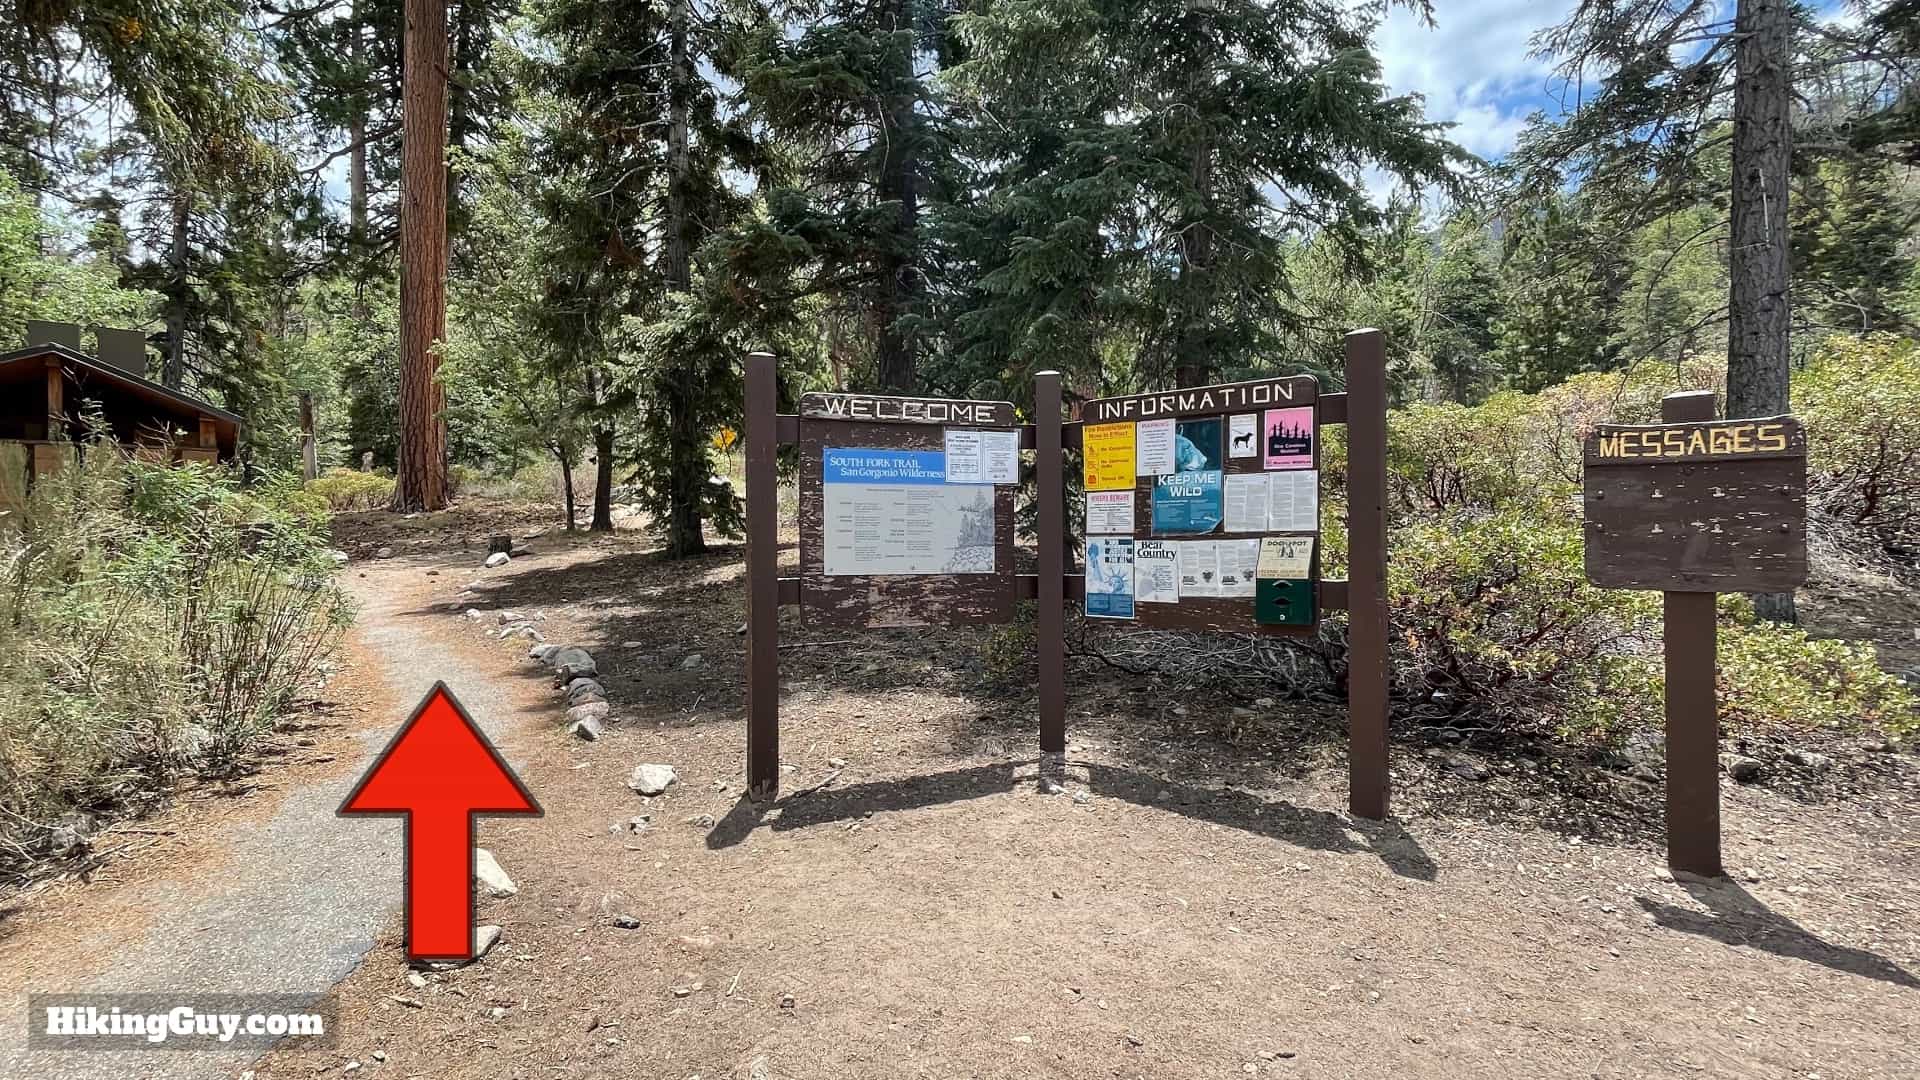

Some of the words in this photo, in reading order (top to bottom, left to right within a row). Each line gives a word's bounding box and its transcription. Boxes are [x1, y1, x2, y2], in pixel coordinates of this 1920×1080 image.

[1099, 382, 1293, 420] INFORMATION
[823, 398, 996, 423] WELCOME
[1599, 424, 1786, 458] MESSAGES
[830, 456, 863, 467] SOUTH
[866, 458, 890, 468] FORK
[893, 459, 921, 469] TRAIL
[840, 468, 858, 477] San
[859, 468, 898, 479] Gorgonio
[899, 469, 945, 479] Wilderness
[1158, 474, 1190, 486] KEEP
[1194, 473, 1216, 484] ME
[1170, 486, 1202, 497] WILD
[1141, 541, 1163, 550] Bear
[1137, 549, 1177, 561] Country
